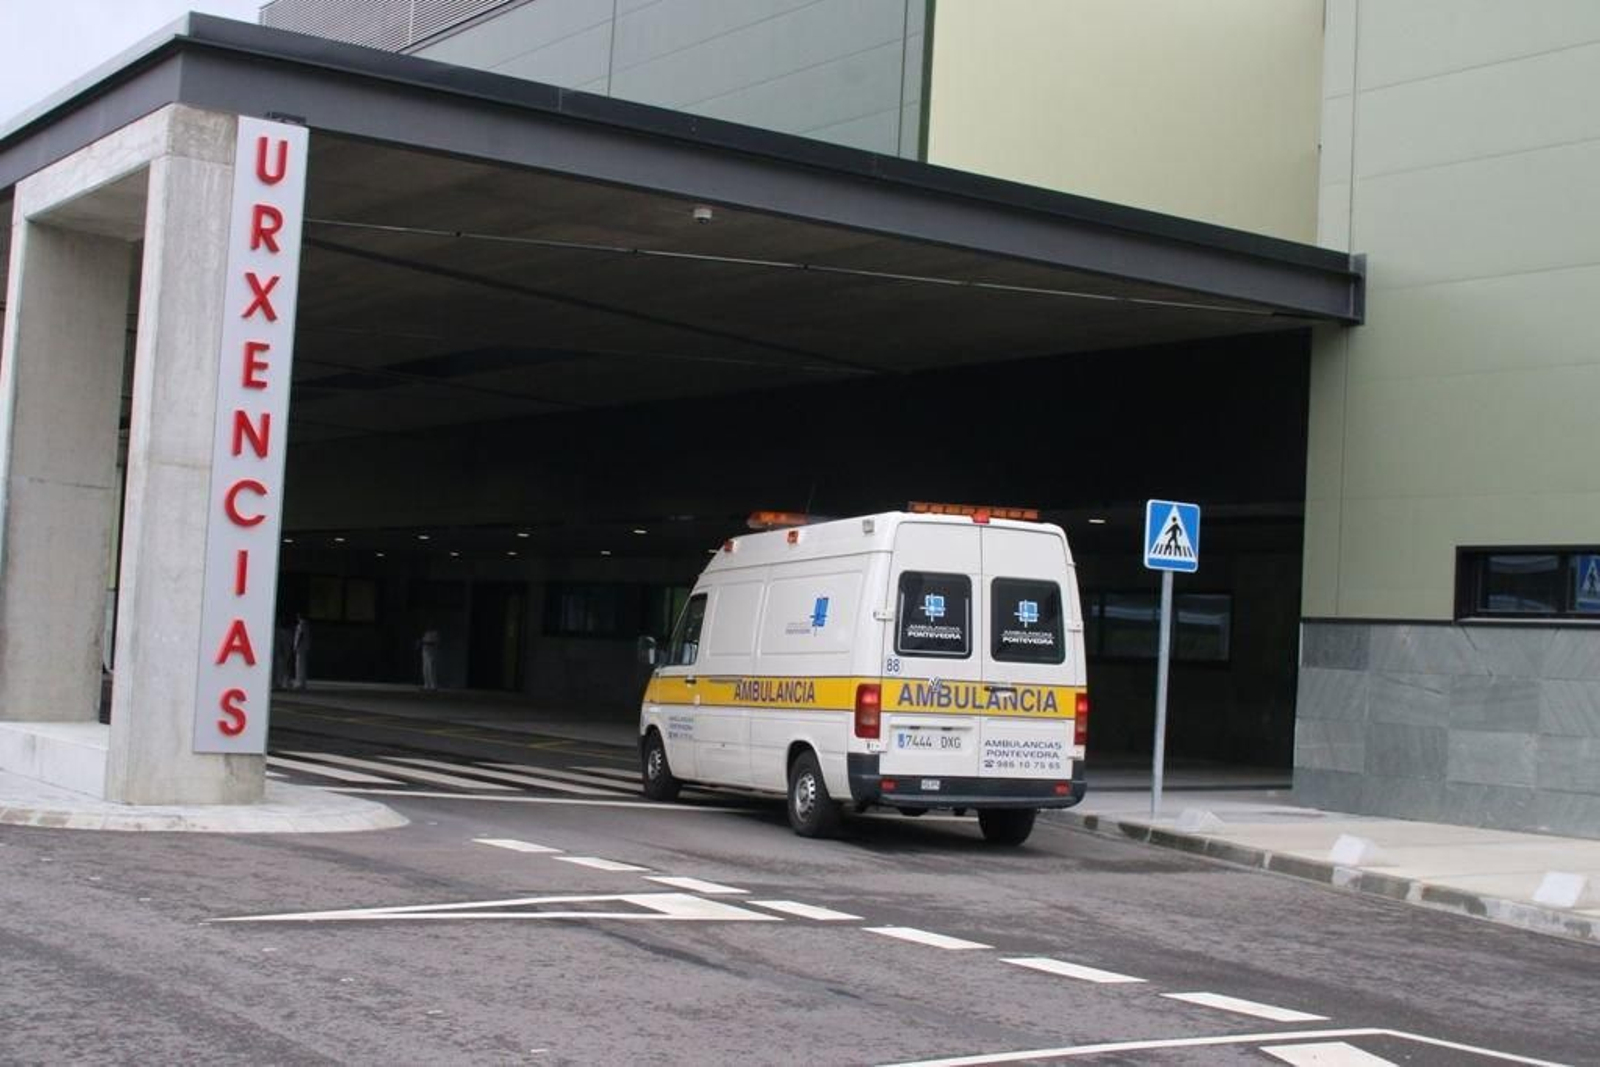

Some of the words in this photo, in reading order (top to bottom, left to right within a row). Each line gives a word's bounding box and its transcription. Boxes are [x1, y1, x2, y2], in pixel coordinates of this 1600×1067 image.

[216, 135, 288, 736] URXENCIAS
[907, 631, 961, 640] PONTEVEDRA
[1002, 636, 1054, 645] PONTEVEDRA
[887, 658, 900, 672] 88
[733, 680, 815, 703] AMBULANCIA
[897, 683, 1058, 713] AMBULANCIA
[905, 734, 932, 748] 7444
[941, 736, 961, 749] DXG
[984, 739, 1062, 750] AMBULANCIAS
[986, 749, 1060, 759] PONTEVEDRA
[1019, 760, 1030, 769] 10
